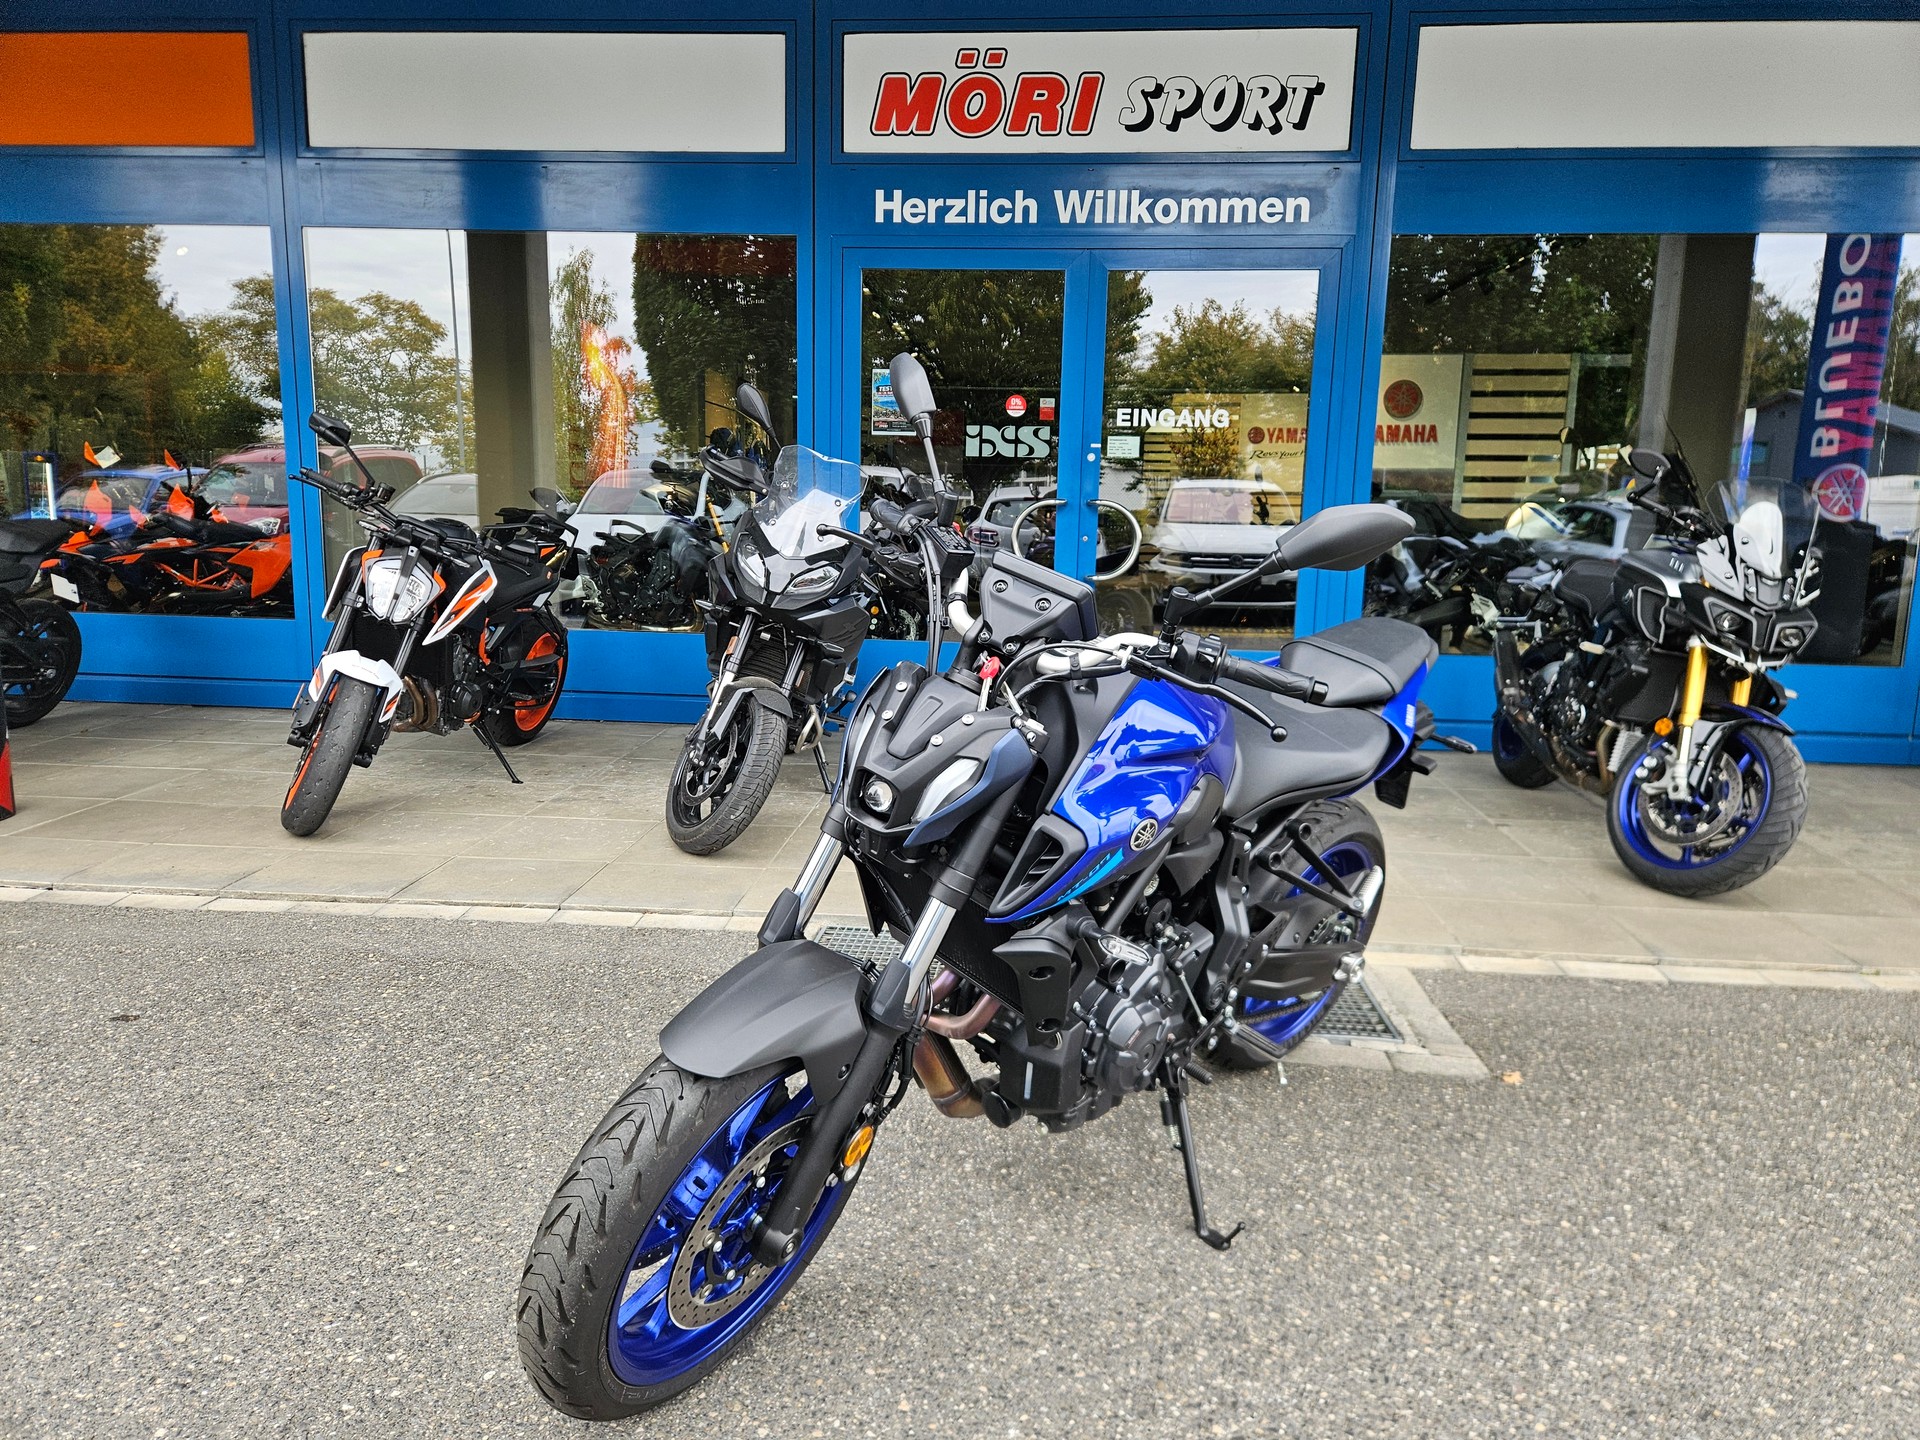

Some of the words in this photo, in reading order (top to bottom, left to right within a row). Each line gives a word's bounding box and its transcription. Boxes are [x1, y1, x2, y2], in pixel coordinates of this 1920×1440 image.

[870, 47, 1105, 138] MÖRI
[1118, 74, 1325, 135] SPORT
[875, 189, 1038, 224] Herzlich
[1054, 189, 1311, 224] Willkommen
[1116, 408, 1230, 428] EINGANG
[1249, 450, 1278, 460] Revs
